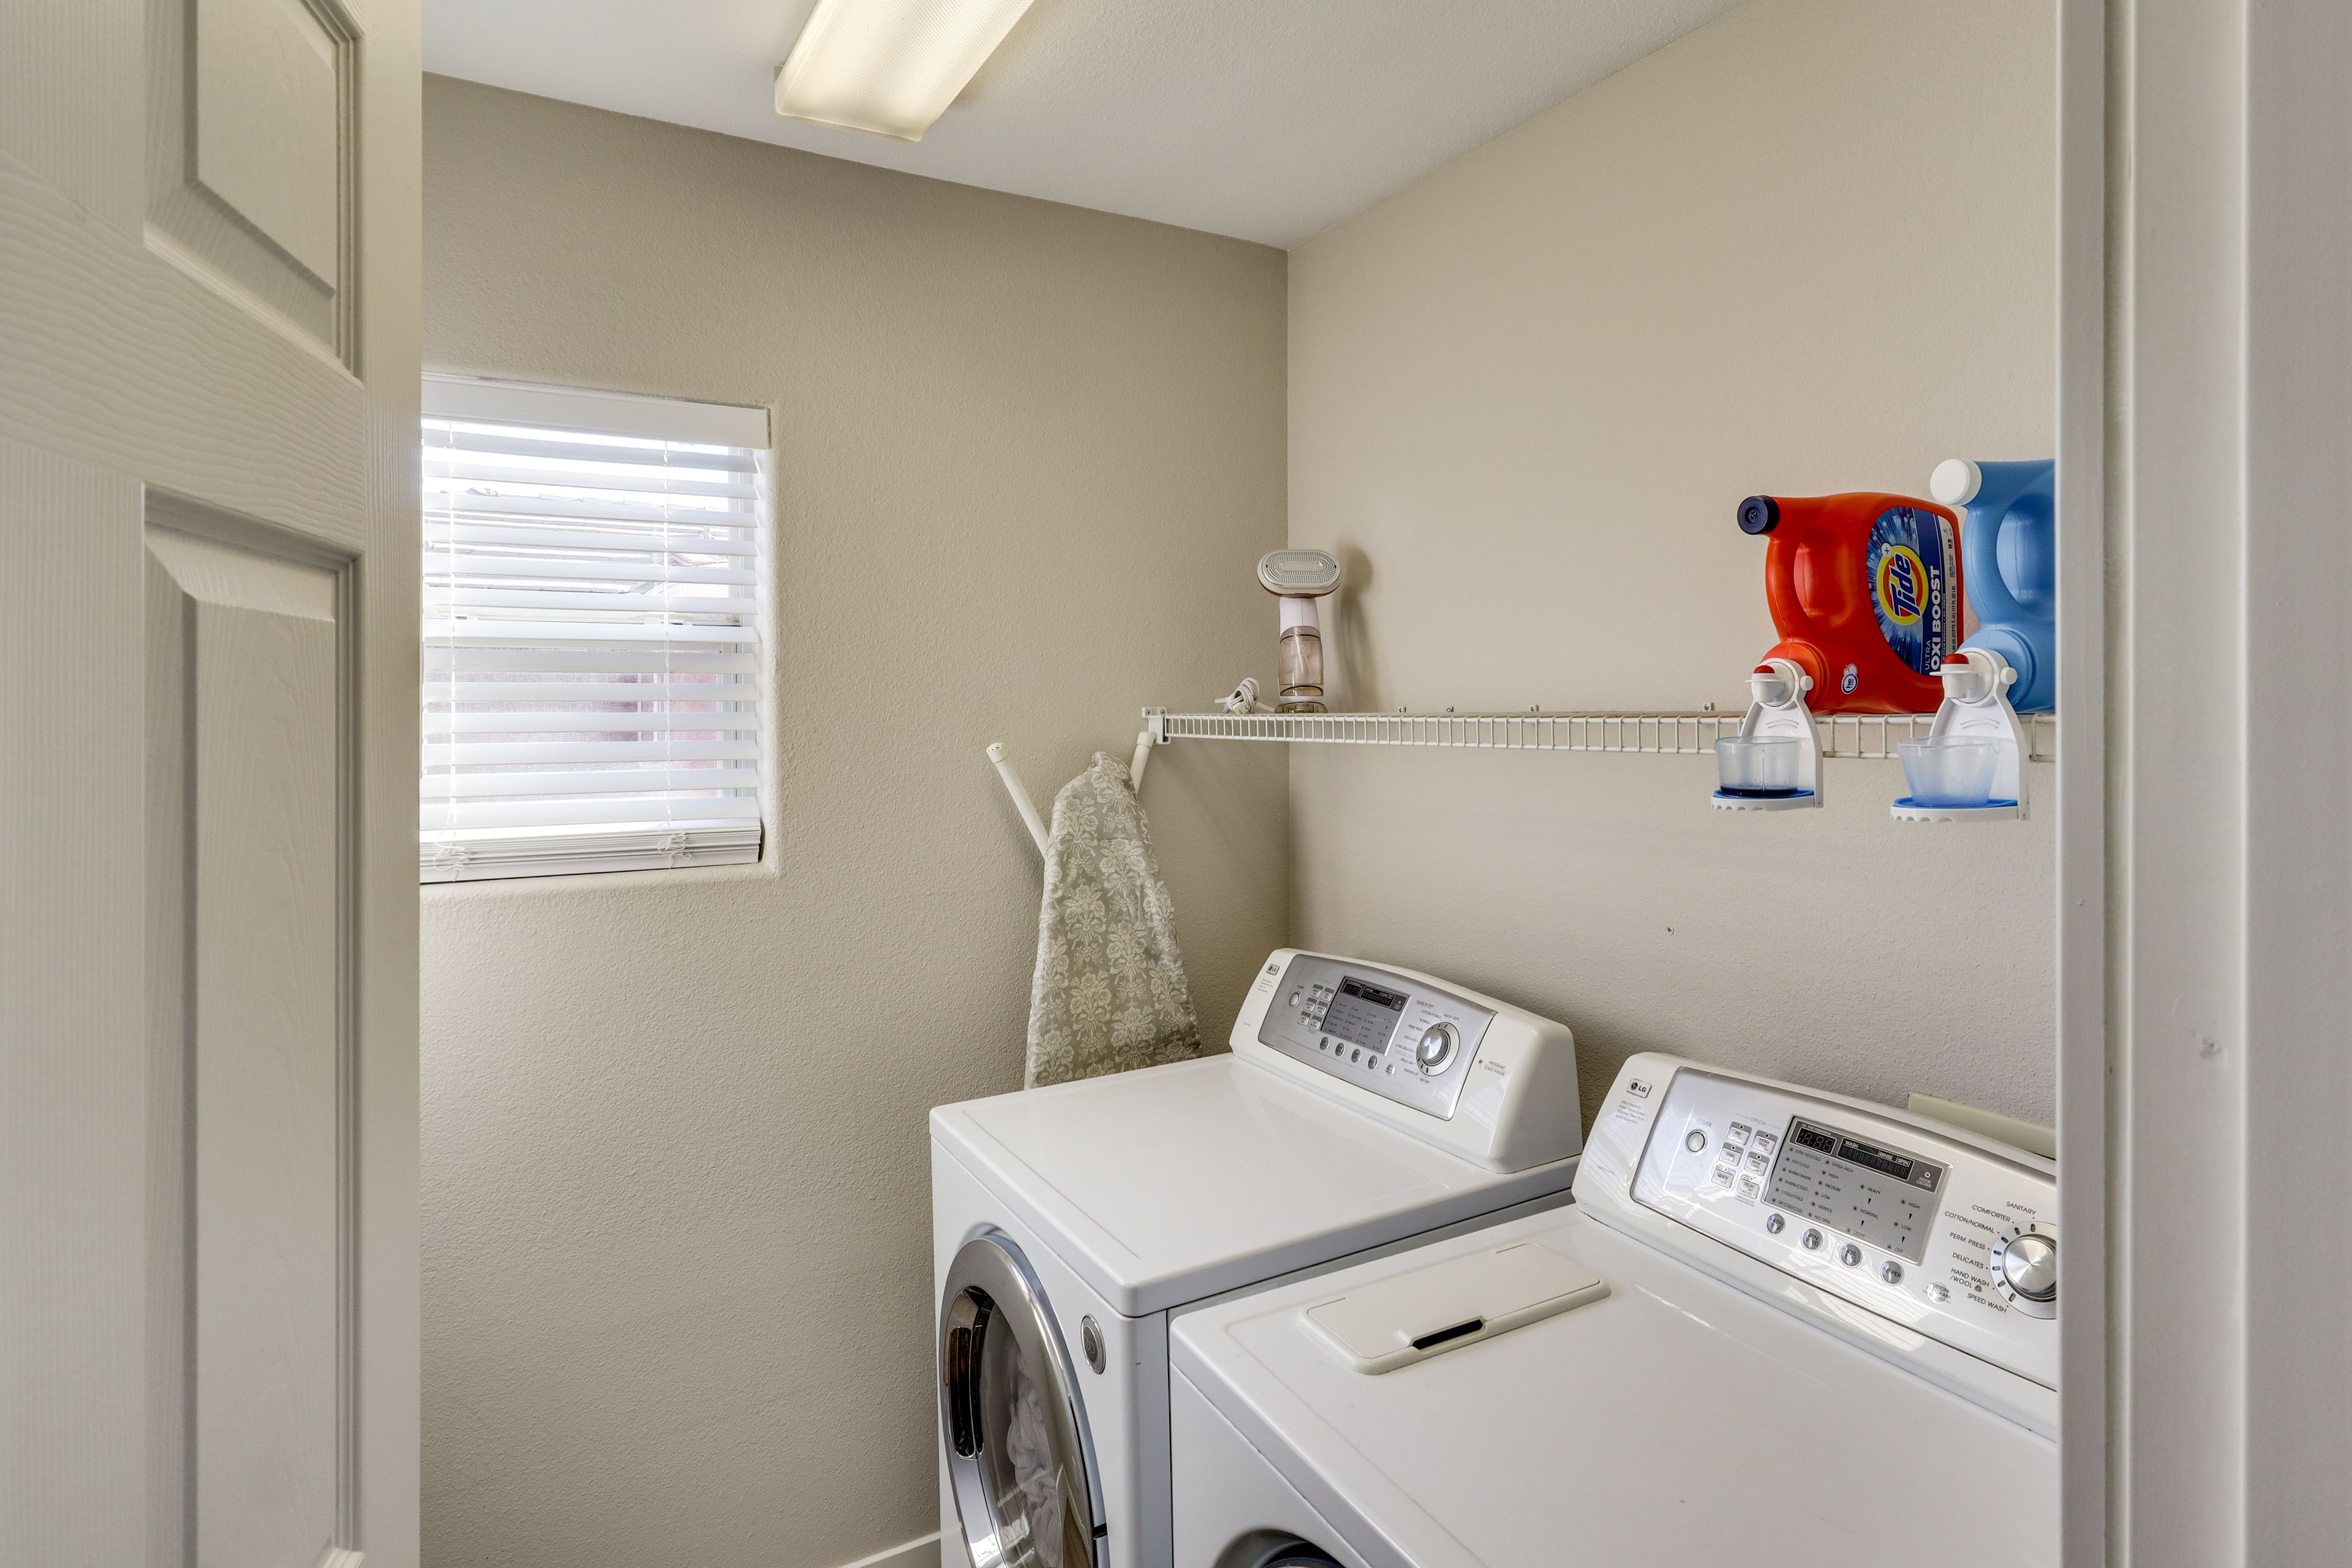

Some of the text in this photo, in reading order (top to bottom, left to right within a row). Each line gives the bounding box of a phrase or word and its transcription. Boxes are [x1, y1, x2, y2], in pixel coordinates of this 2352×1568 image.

[1889, 553, 1921, 618] Tide
[1930, 565, 1942, 671] OXI BOOST
[1825, 1183, 1841, 1192] MEDIUM
[1867, 1186, 1881, 1195] HEAVY
[1818, 1204, 1833, 1213] GENTLE
[1860, 1208, 1879, 1219] NORMAL
[1972, 1204, 2011, 1223] COMFORTER
[2006, 1201, 2037, 1215] SANITARY
[1945, 1211, 1994, 1234] COTTON/NORMAL
[1950, 1232, 1986, 1250] PERM. PRESS
[1952, 1253, 1984, 1269] DELICATES
[1950, 1275, 1972, 1289] /WOOL
[1951, 1268, 1989, 1287] HAND WASH
[1967, 1293, 2007, 1313] SPEED WASH
